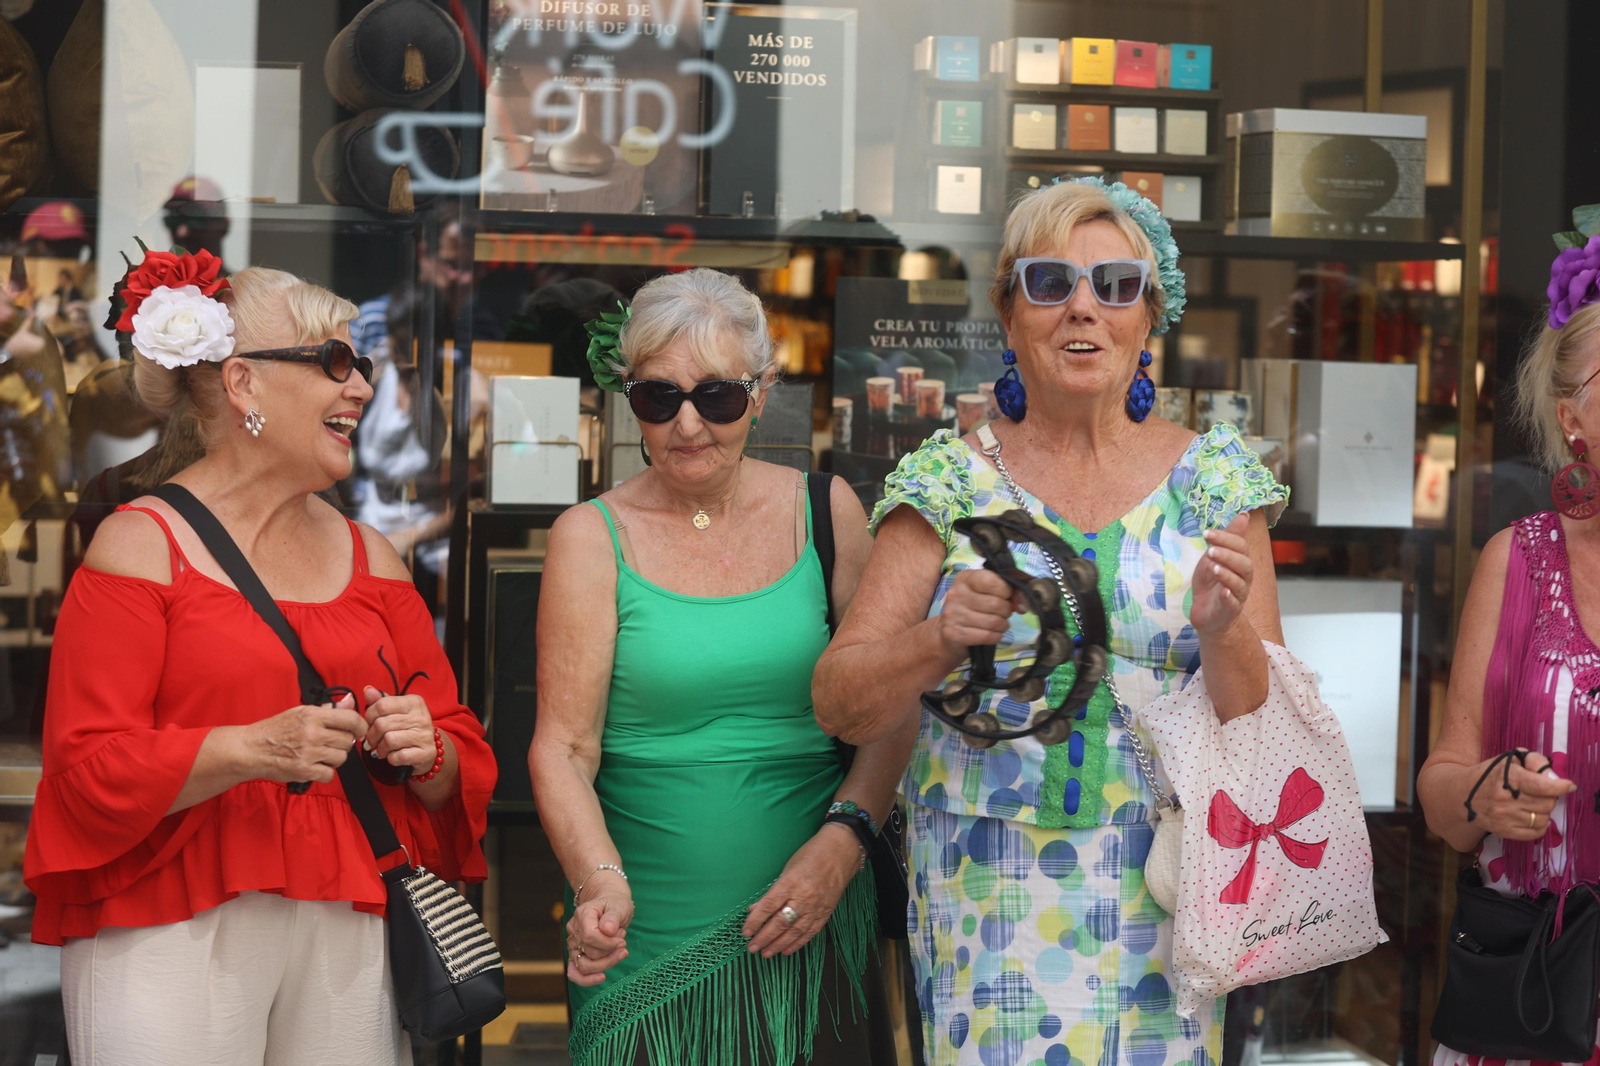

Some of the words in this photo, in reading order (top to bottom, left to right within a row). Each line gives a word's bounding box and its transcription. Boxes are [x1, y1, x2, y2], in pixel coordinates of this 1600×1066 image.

[540, 0, 620, 16] DIFUSOR
[627, 4, 651, 17] DE
[512, 18, 596, 33] PERFUME
[602, 21, 626, 34] DE
[633, 23, 677, 38] LUJO
[748, 32, 784, 48] MÁS
[789, 35, 814, 49] DE
[750, 53, 778, 66] 270
[782, 54, 811, 67] 000
[733, 70, 827, 87] VENDIDOS
[873, 319, 915, 332] CREA
[919, 320, 939, 332] TU
[945, 321, 1000, 334] PROPIA
[869, 335, 909, 348] VELA
[913, 335, 1004, 350] AROMÁTICA
[1242, 918, 1293, 948] Sweet
[1296, 899, 1334, 935] Love
